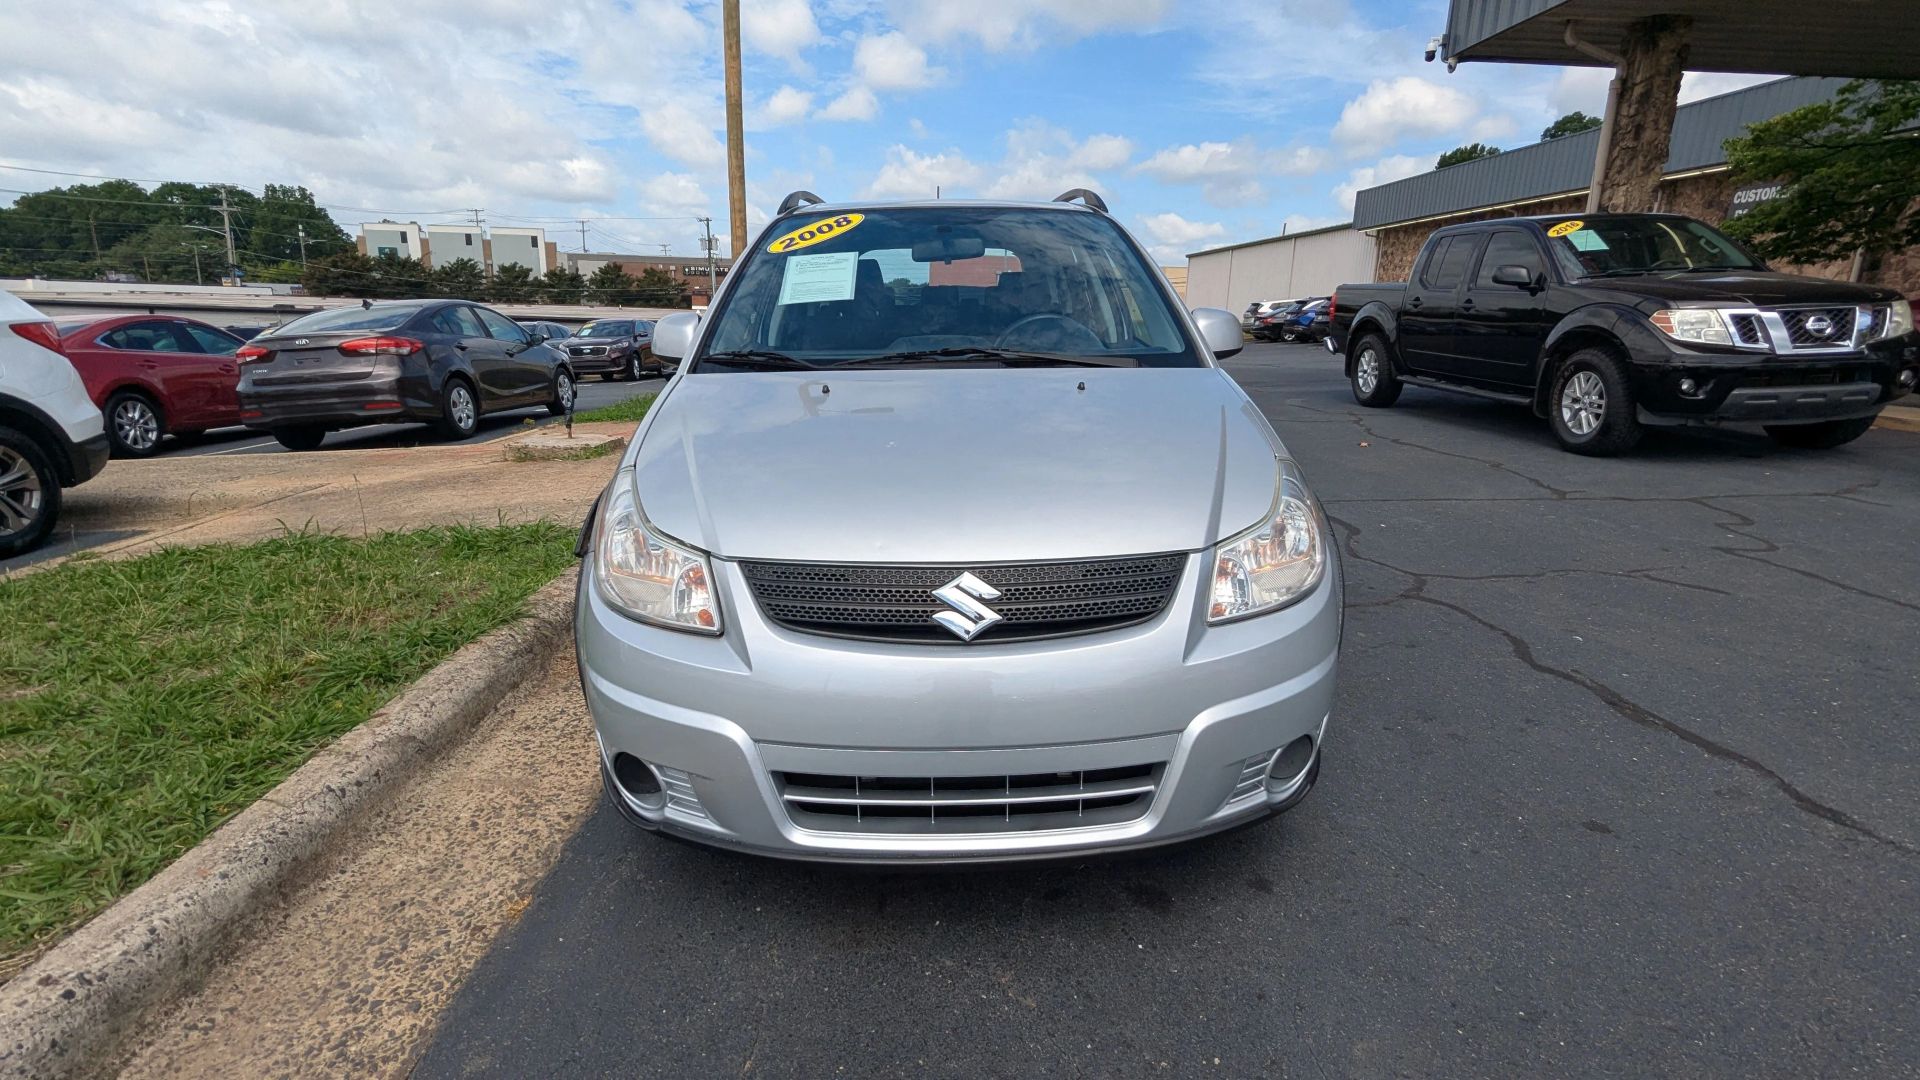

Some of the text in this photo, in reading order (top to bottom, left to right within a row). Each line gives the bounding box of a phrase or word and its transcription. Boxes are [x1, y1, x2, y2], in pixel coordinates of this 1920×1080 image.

[1733, 185, 1790, 204] CUSTOM
[779, 216, 853, 250] 2008
[1553, 221, 1579, 235] 2016
